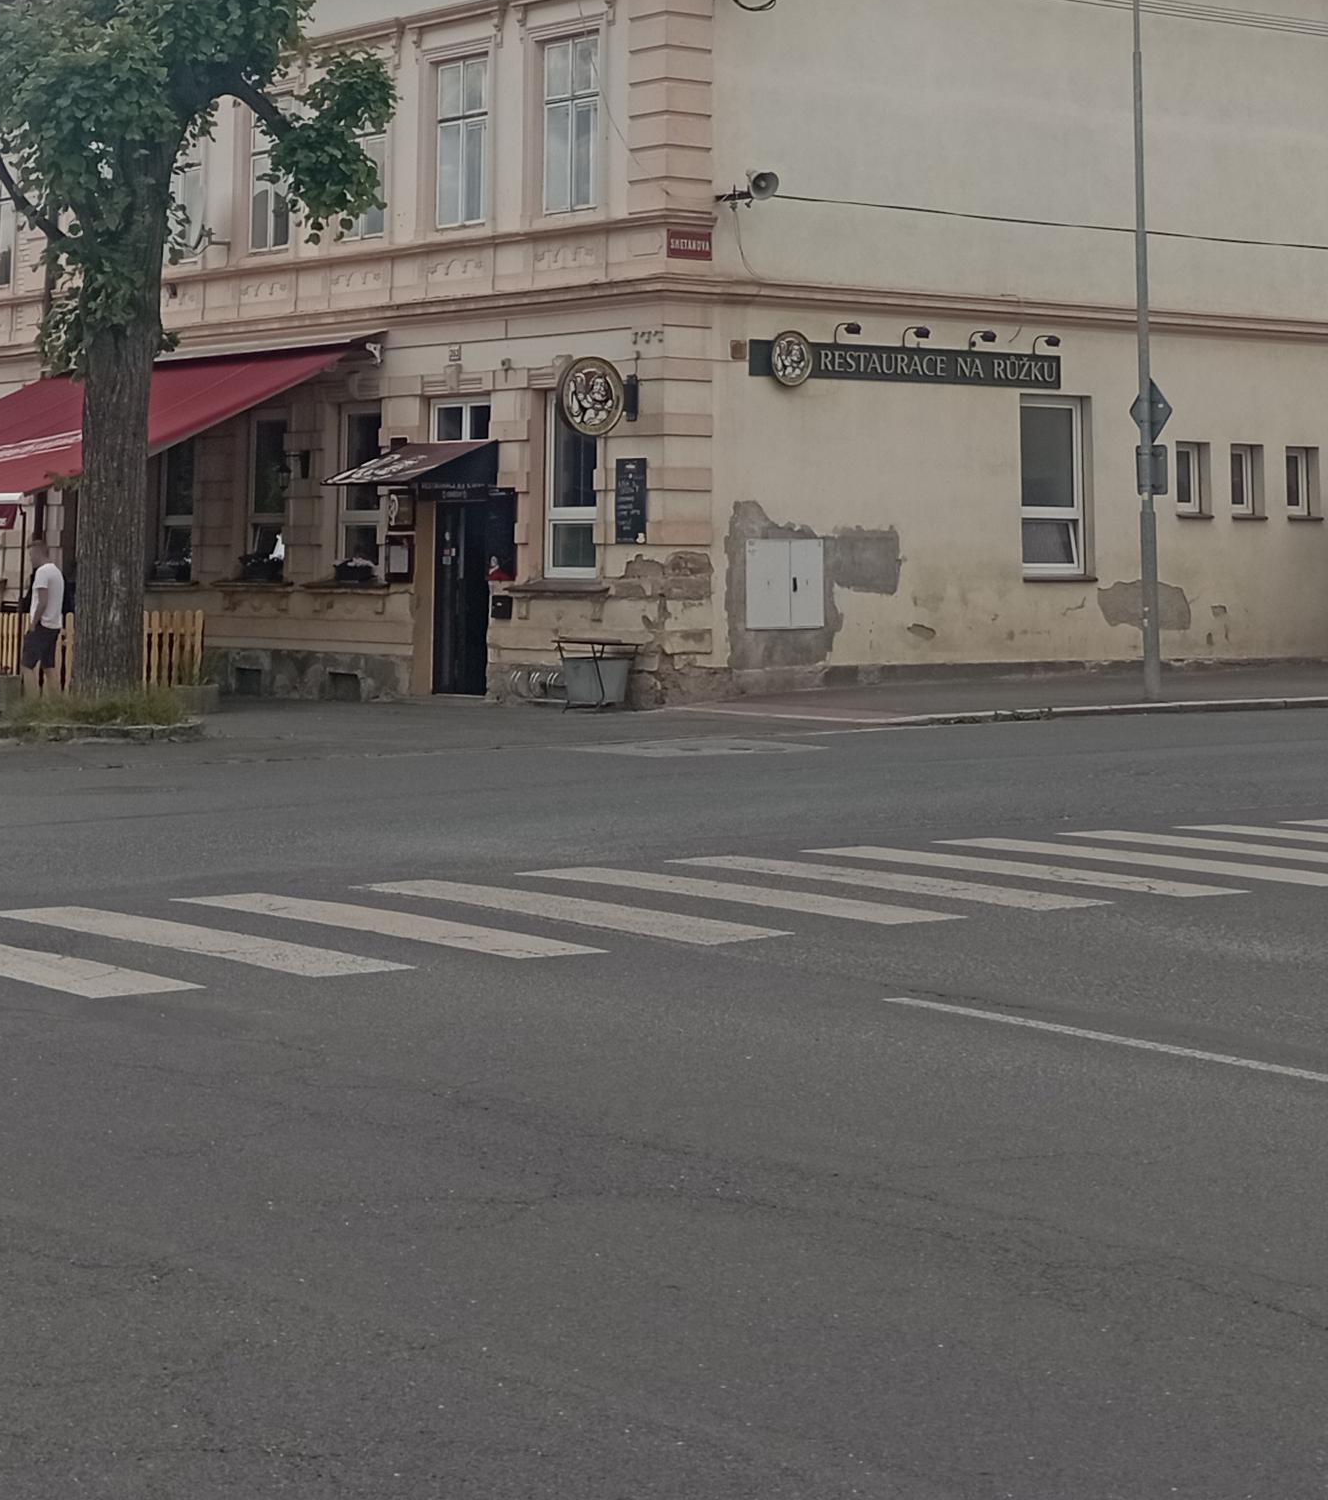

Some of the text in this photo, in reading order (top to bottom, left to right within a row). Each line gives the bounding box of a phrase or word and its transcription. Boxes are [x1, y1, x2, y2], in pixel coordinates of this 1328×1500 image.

[670, 238, 711, 252] SMETANOVA
[820, 349, 1057, 382] RESTAURACE NA RŮŽKU
